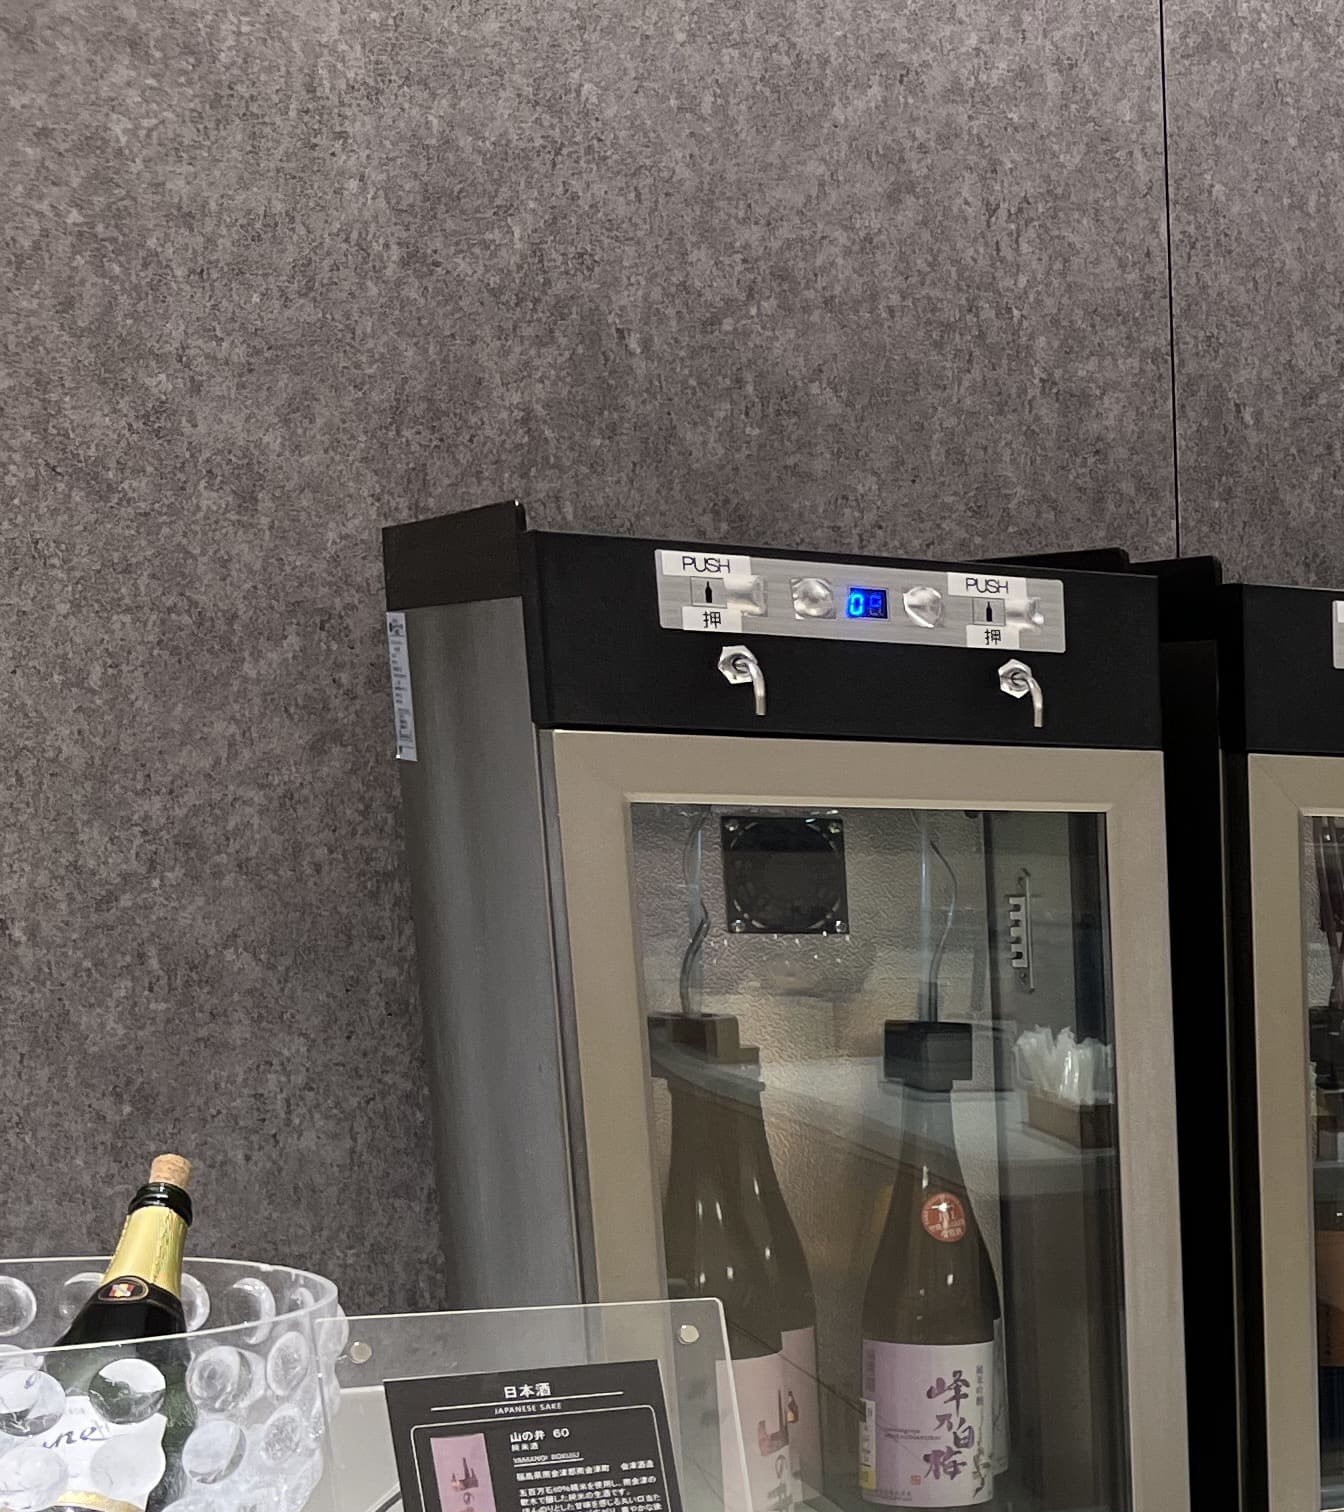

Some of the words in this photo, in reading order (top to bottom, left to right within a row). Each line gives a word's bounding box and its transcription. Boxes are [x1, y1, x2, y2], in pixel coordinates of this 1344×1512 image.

[682, 555, 731, 573] PUSH
[965, 577, 1009, 594] PUSH
[702, 611, 722, 629] 押
[984, 629, 1002, 645] 押
[503, 1382, 552, 1399] 日本酒
[494, 1404, 537, 1415] JAPANESE
[539, 1402, 563, 1411] SAKE
[552, 1427, 570, 1438] 60
